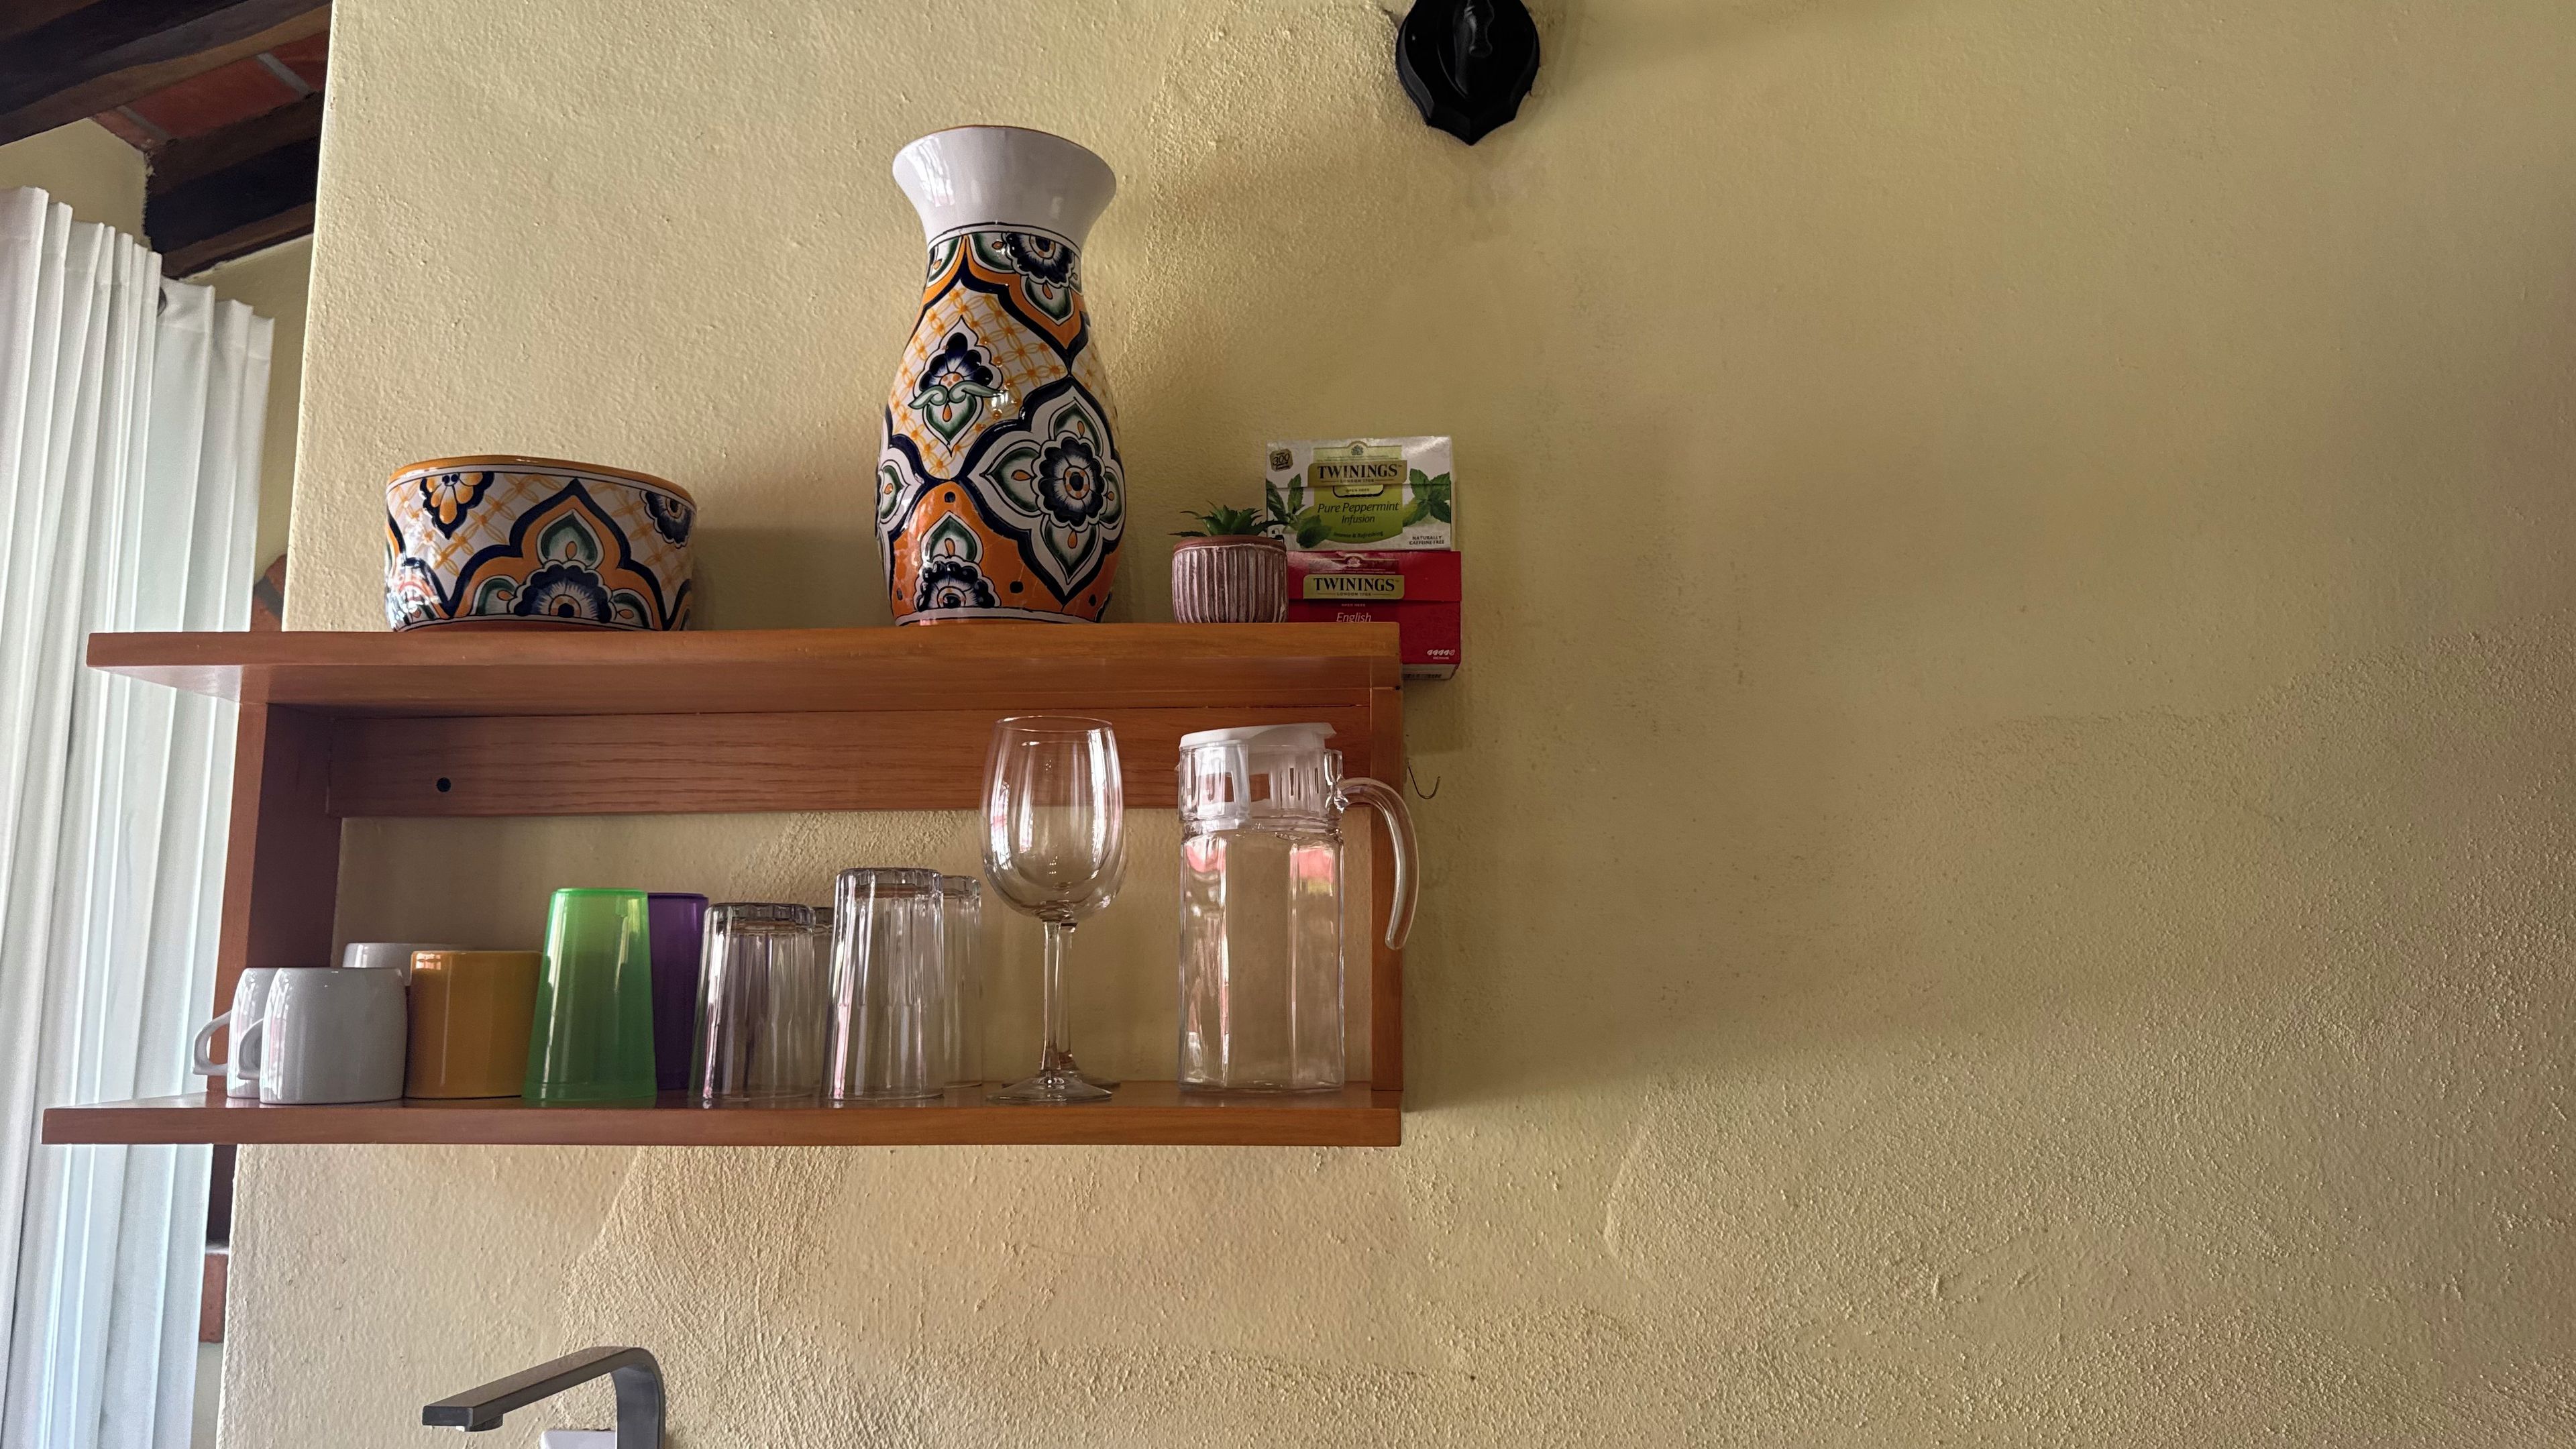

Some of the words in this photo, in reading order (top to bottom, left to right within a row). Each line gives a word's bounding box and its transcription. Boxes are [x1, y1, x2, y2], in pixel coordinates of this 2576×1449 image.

[1317, 463, 1398, 479] TWININGS
[1318, 503, 1341, 513] Pure
[1342, 501, 1400, 514] Peppermint
[1342, 515, 1375, 525] Infusion
[1313, 578, 1395, 592] TWININGS
[1336, 612, 1372, 623] English
